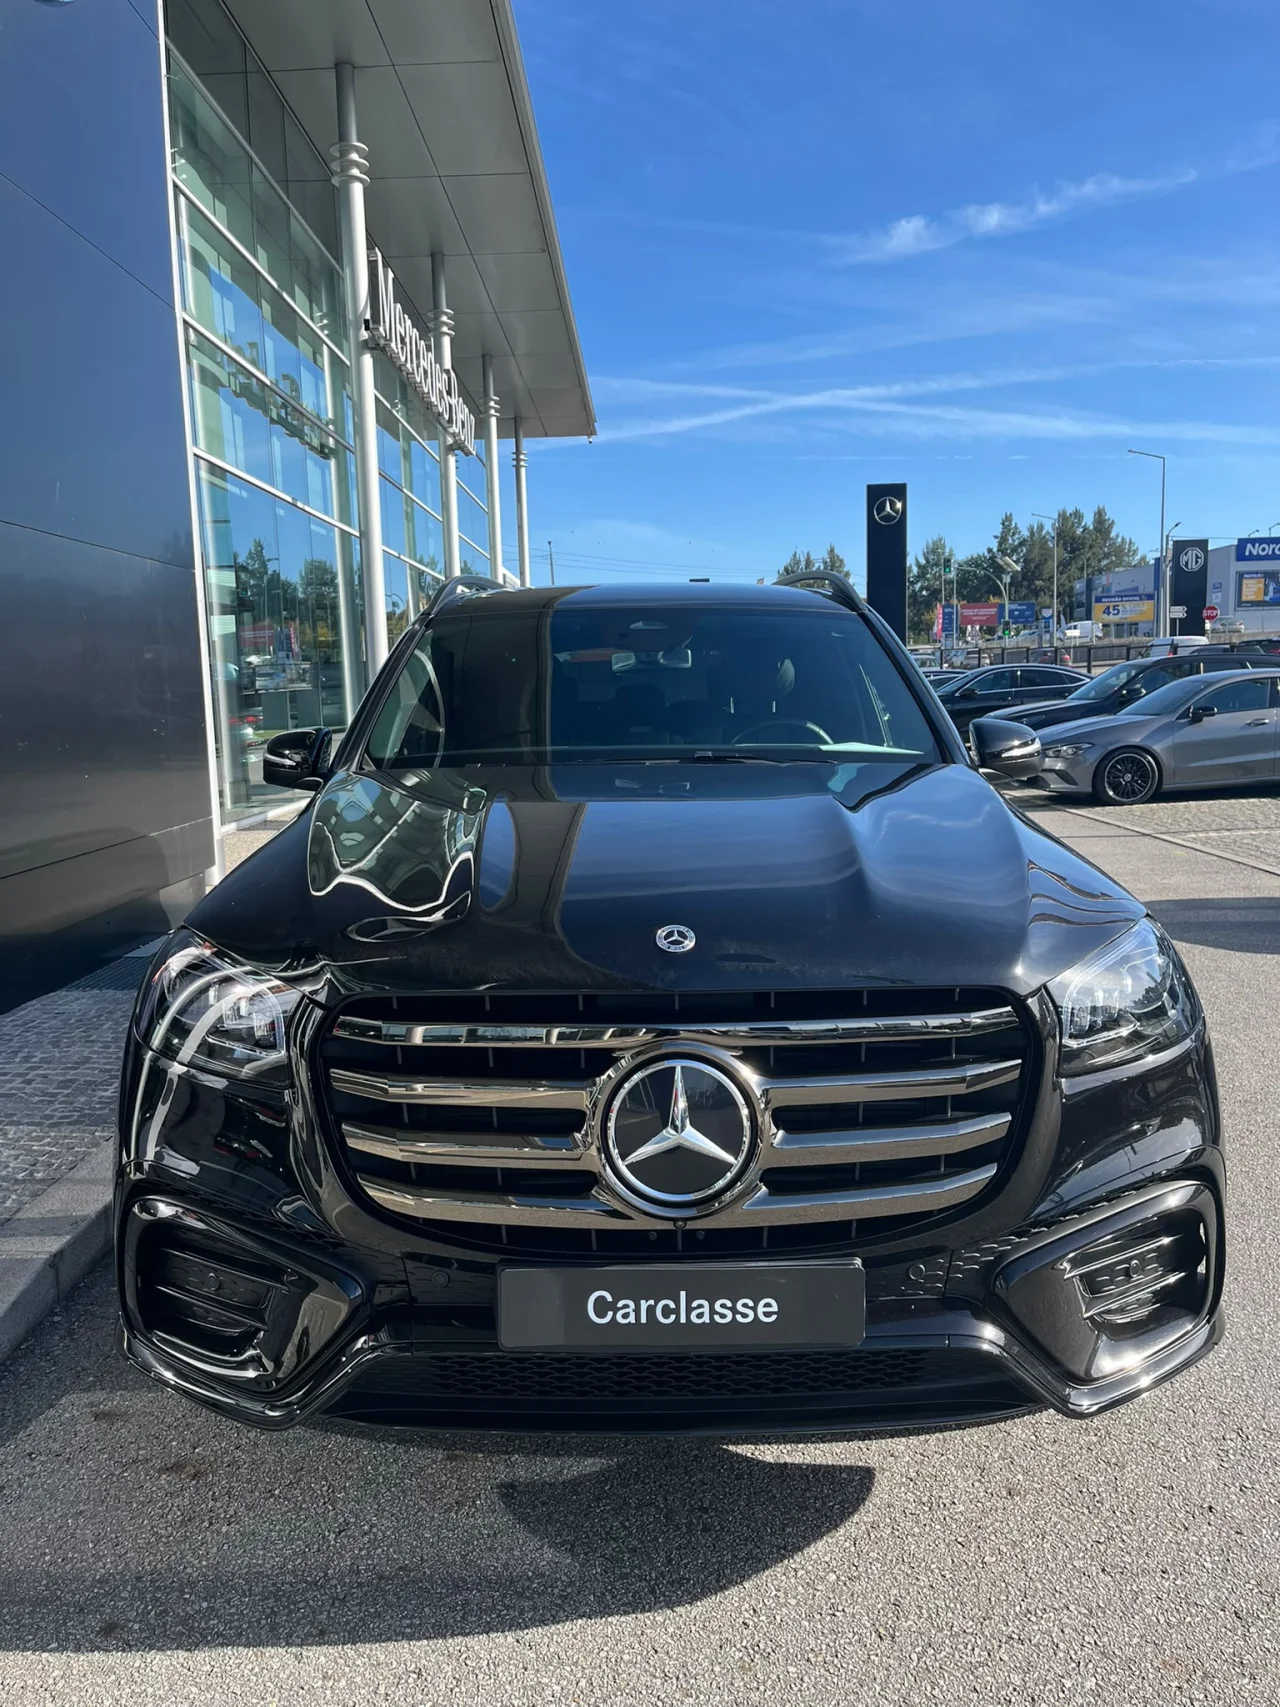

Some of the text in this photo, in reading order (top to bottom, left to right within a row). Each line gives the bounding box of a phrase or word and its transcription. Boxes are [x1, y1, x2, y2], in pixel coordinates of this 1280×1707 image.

[375, 246, 476, 456] Mercedes-Benz
[1182, 549, 1202, 569] MG
[1203, 609, 1218, 617] STOP
[587, 1289, 779, 1325] Carclasse
